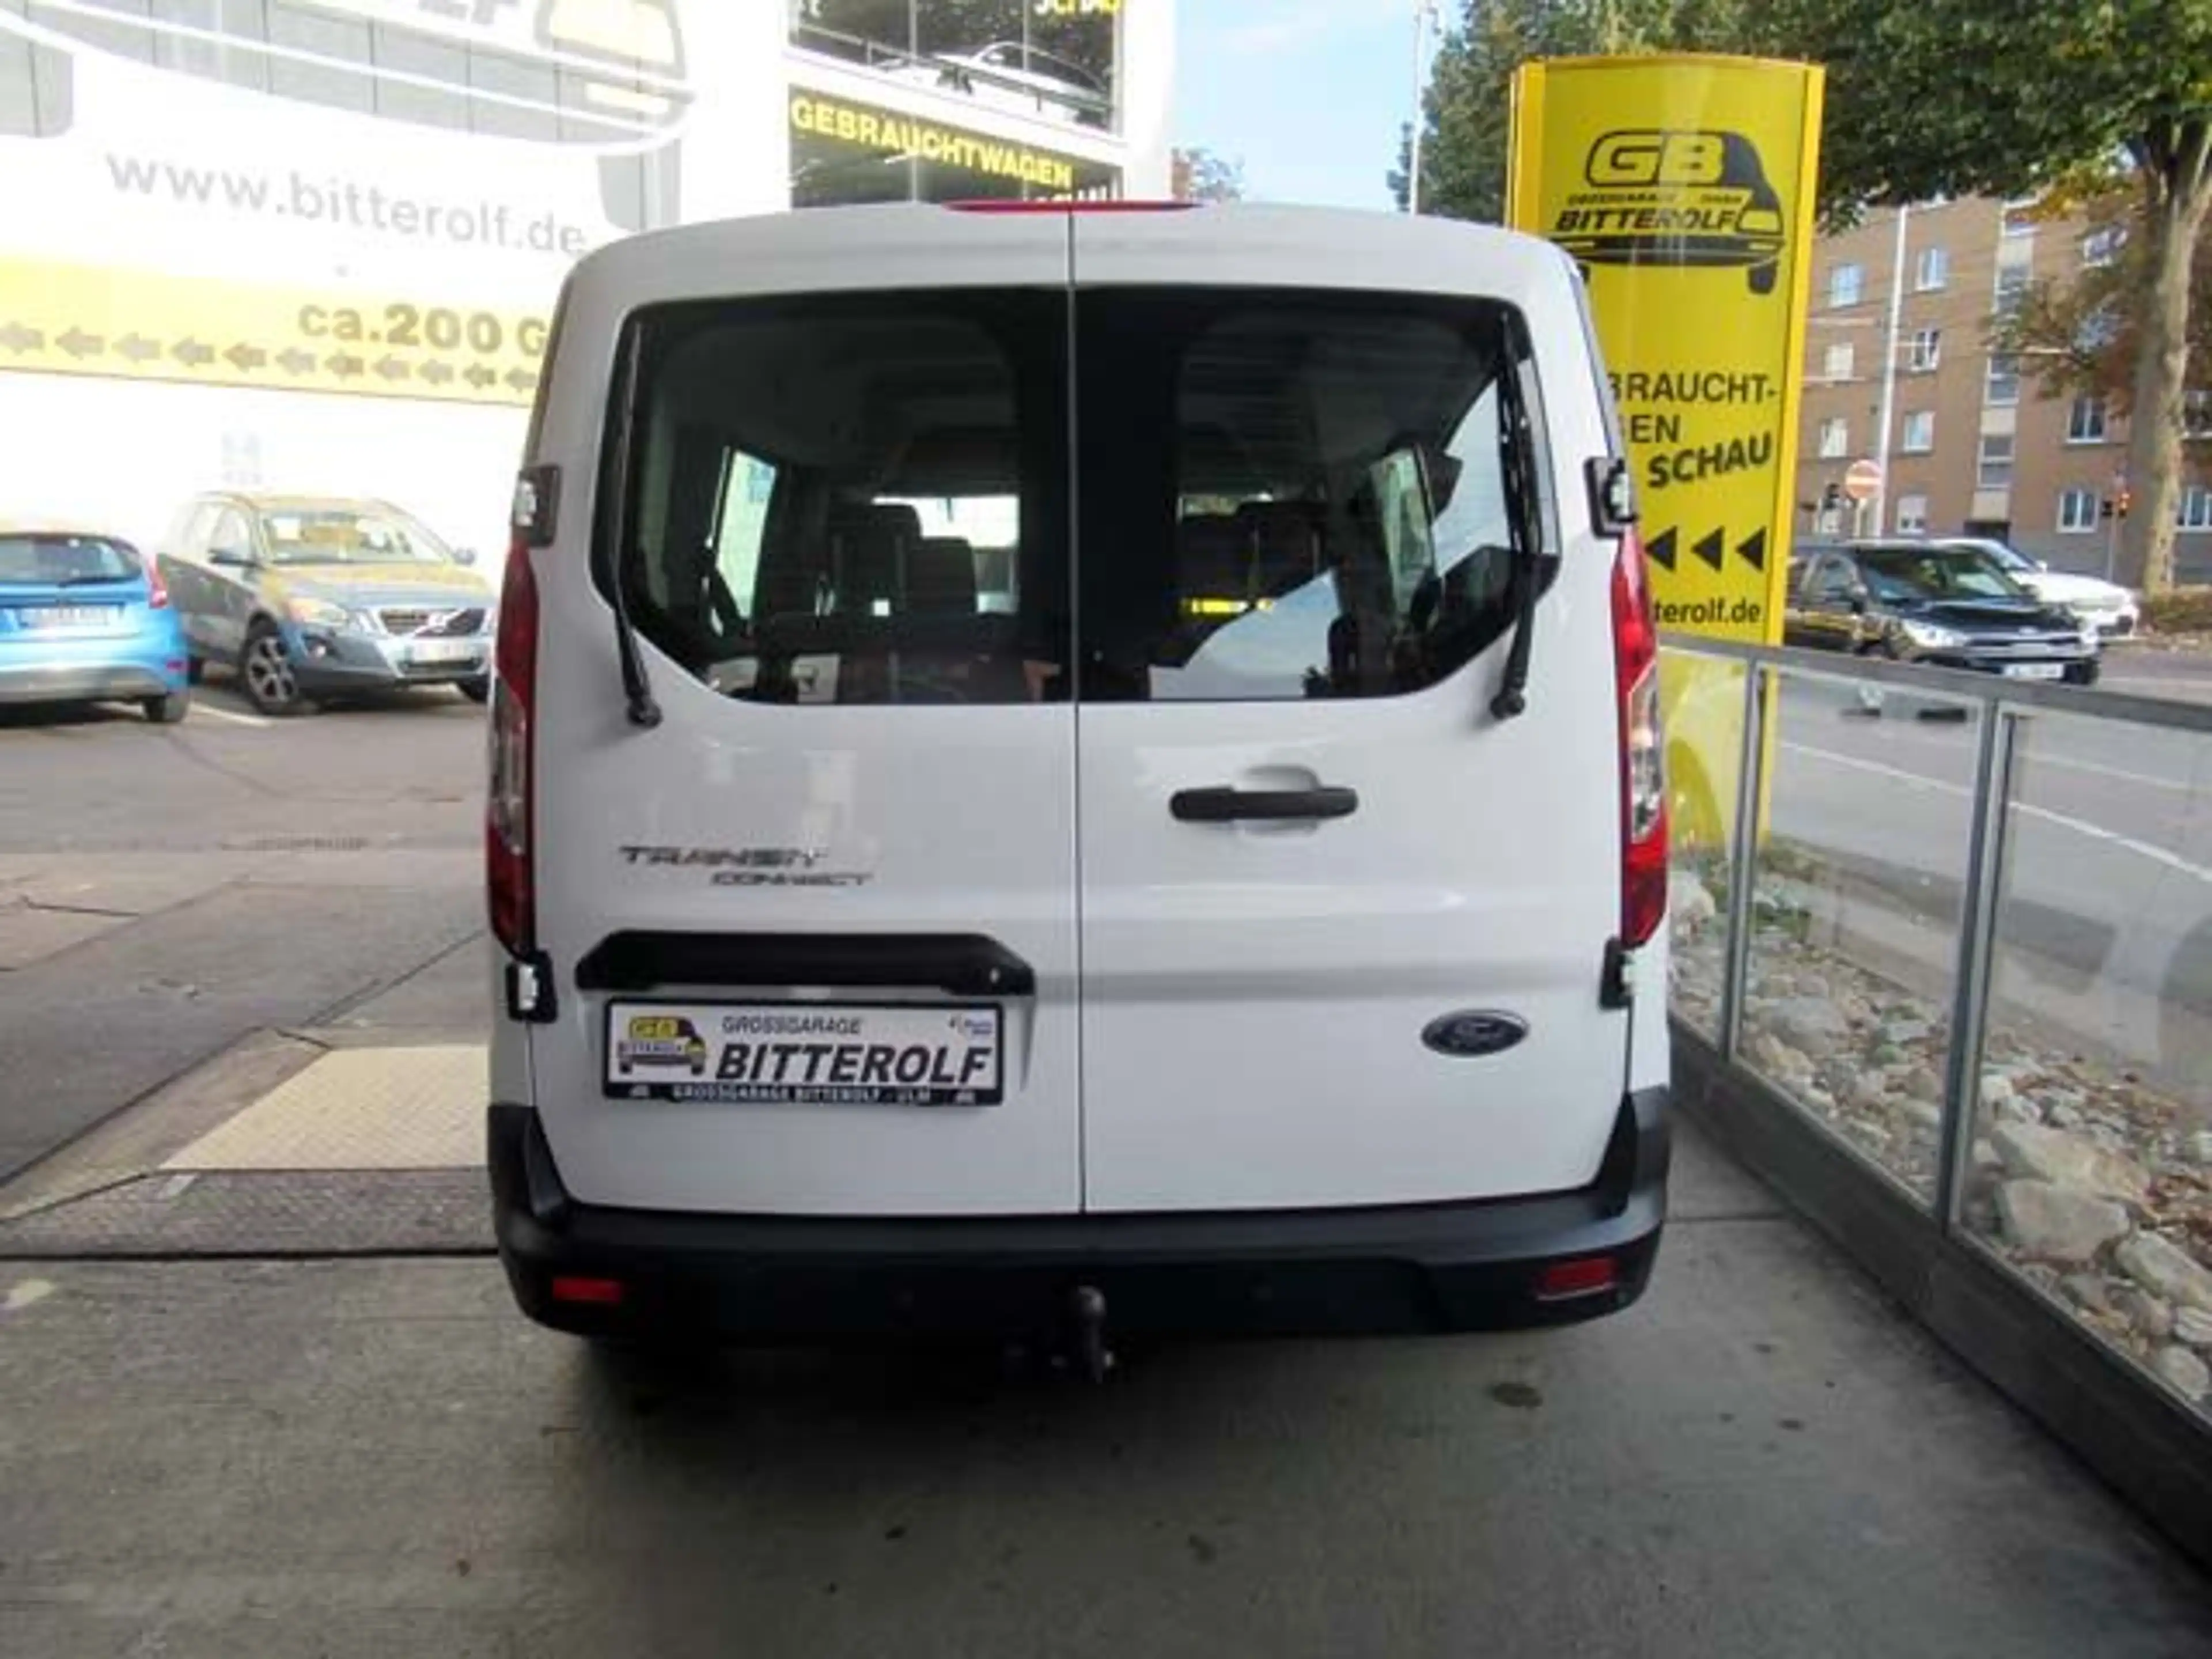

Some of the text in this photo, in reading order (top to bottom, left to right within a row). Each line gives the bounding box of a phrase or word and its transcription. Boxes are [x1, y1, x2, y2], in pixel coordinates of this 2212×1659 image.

[791, 97, 1072, 191] GEBRAUCHTWAGEN
[105, 152, 587, 255] www.bitterolf.de
[1556, 208, 1740, 230] BITTEROLF
[1620, 414, 1681, 444] EN
[1647, 430, 1771, 488] SCHAU
[722, 1016, 862, 1035] GROSSGARAGE
[715, 1042, 993, 1085] BITTEROLF
